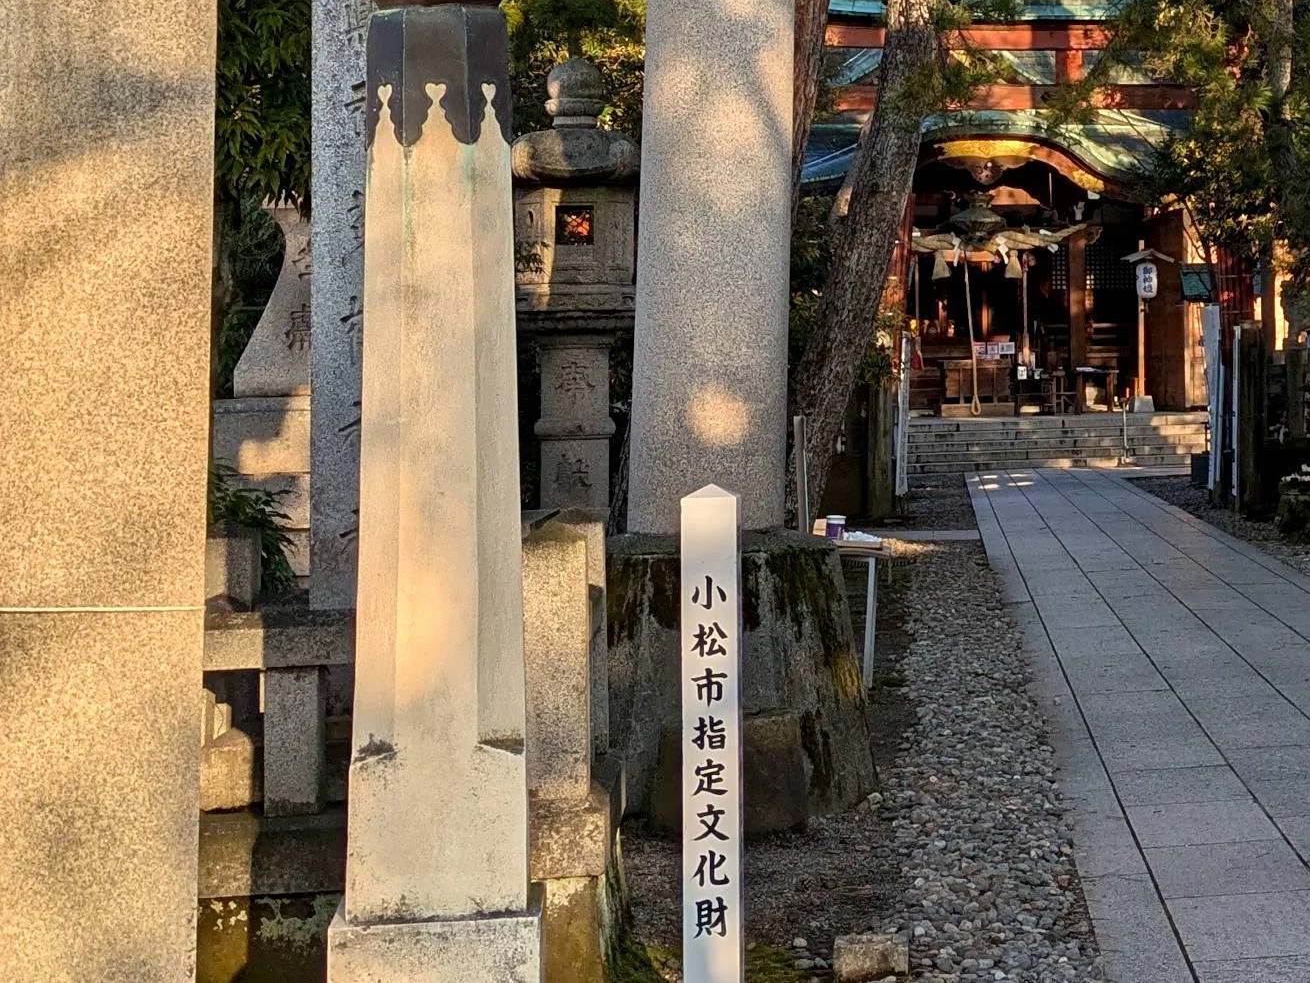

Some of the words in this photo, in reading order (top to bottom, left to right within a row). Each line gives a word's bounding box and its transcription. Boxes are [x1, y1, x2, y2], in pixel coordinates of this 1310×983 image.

[690, 575, 730, 939] 小松市指定文化財
